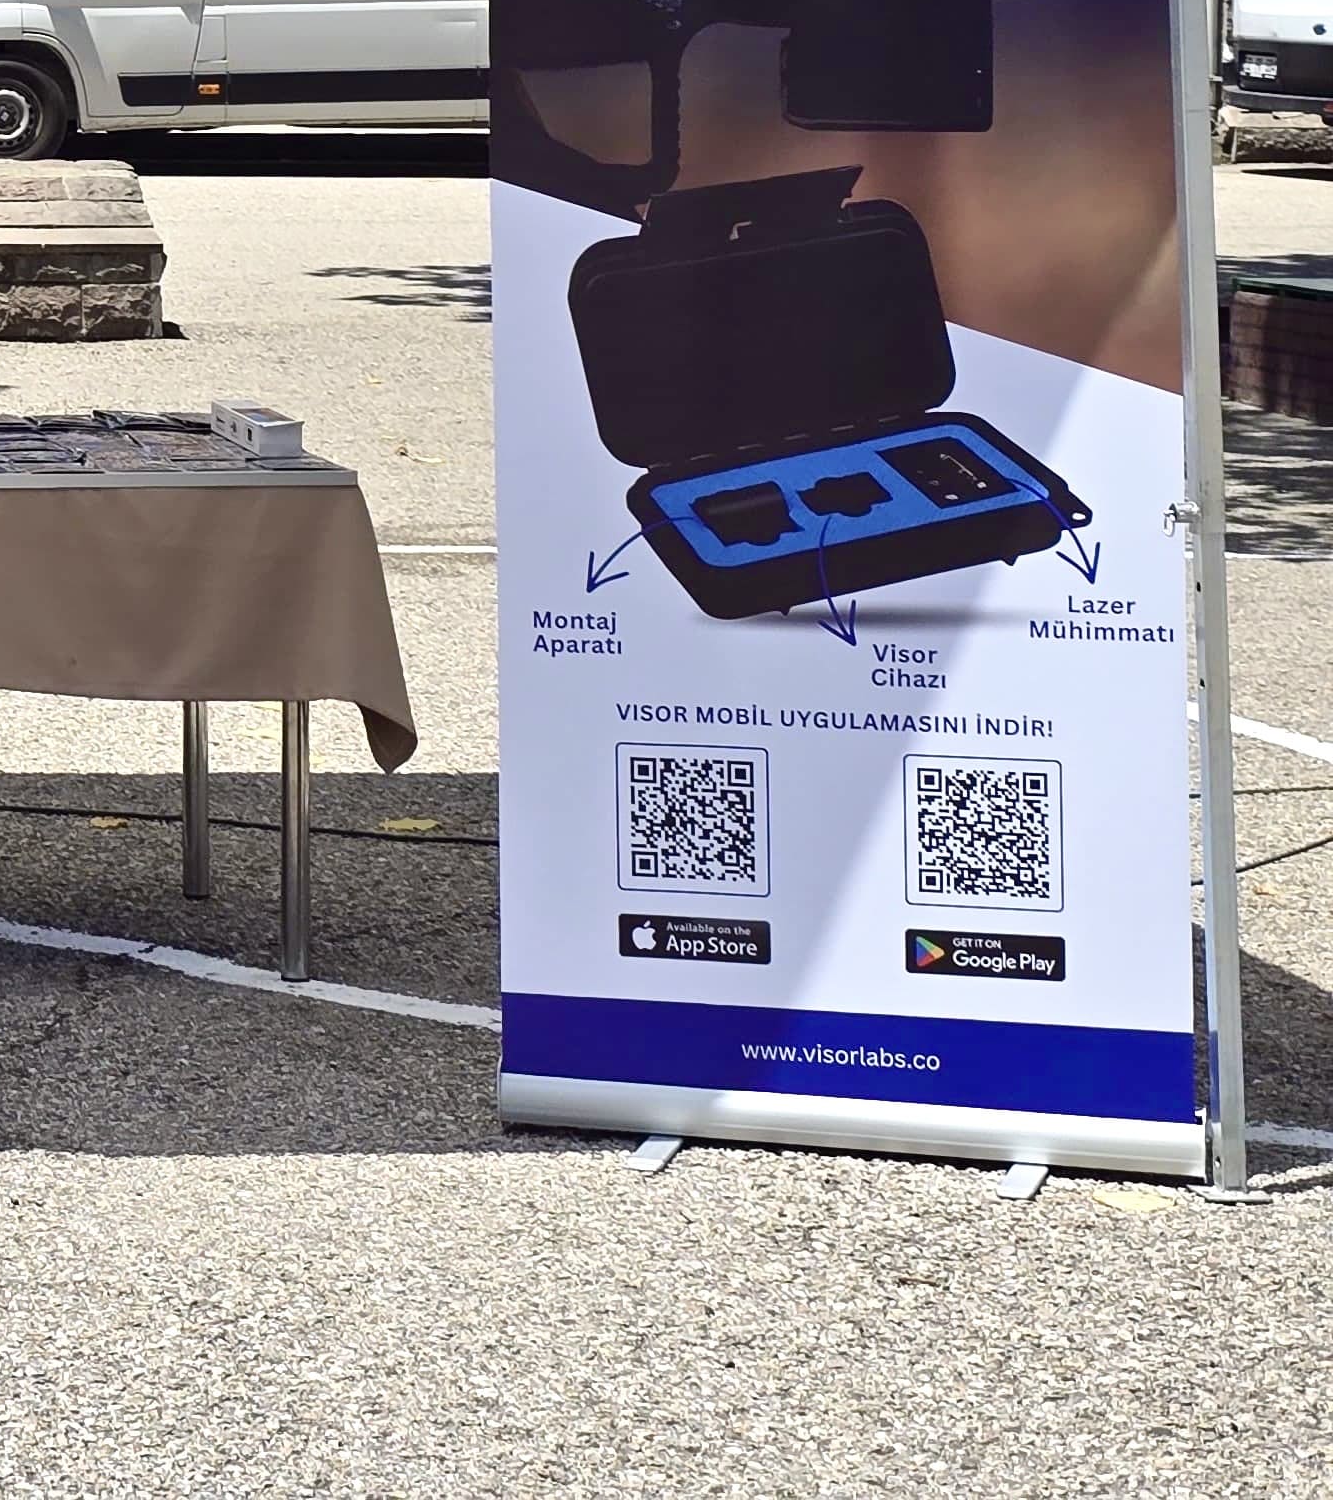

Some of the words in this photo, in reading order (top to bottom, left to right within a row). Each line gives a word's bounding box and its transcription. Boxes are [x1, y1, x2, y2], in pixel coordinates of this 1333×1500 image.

[1068, 595, 1137, 616] Lazer
[532, 611, 617, 636] Montaj
[1029, 619, 1175, 644] Mühimmatı
[532, 634, 623, 658] Aparatı
[872, 644, 938, 665] Visor
[871, 668, 947, 690] Cihazı
[617, 703, 688, 723] VISOR
[696, 705, 772, 727] MOBİL
[781, 711, 967, 735] UYGULAMASINI
[977, 713, 1053, 737] İNDİR!
[667, 921, 714, 935] Available
[718, 924, 731, 935] on
[735, 925, 751, 936] the
[666, 935, 705, 956] App
[708, 937, 757, 956] Store
[953, 938, 971, 949] GET
[987, 939, 1001, 949] ON
[953, 950, 1016, 973] Google
[1021, 953, 1055, 975] Play
[742, 1041, 940, 1071] www.visorlabs.co
